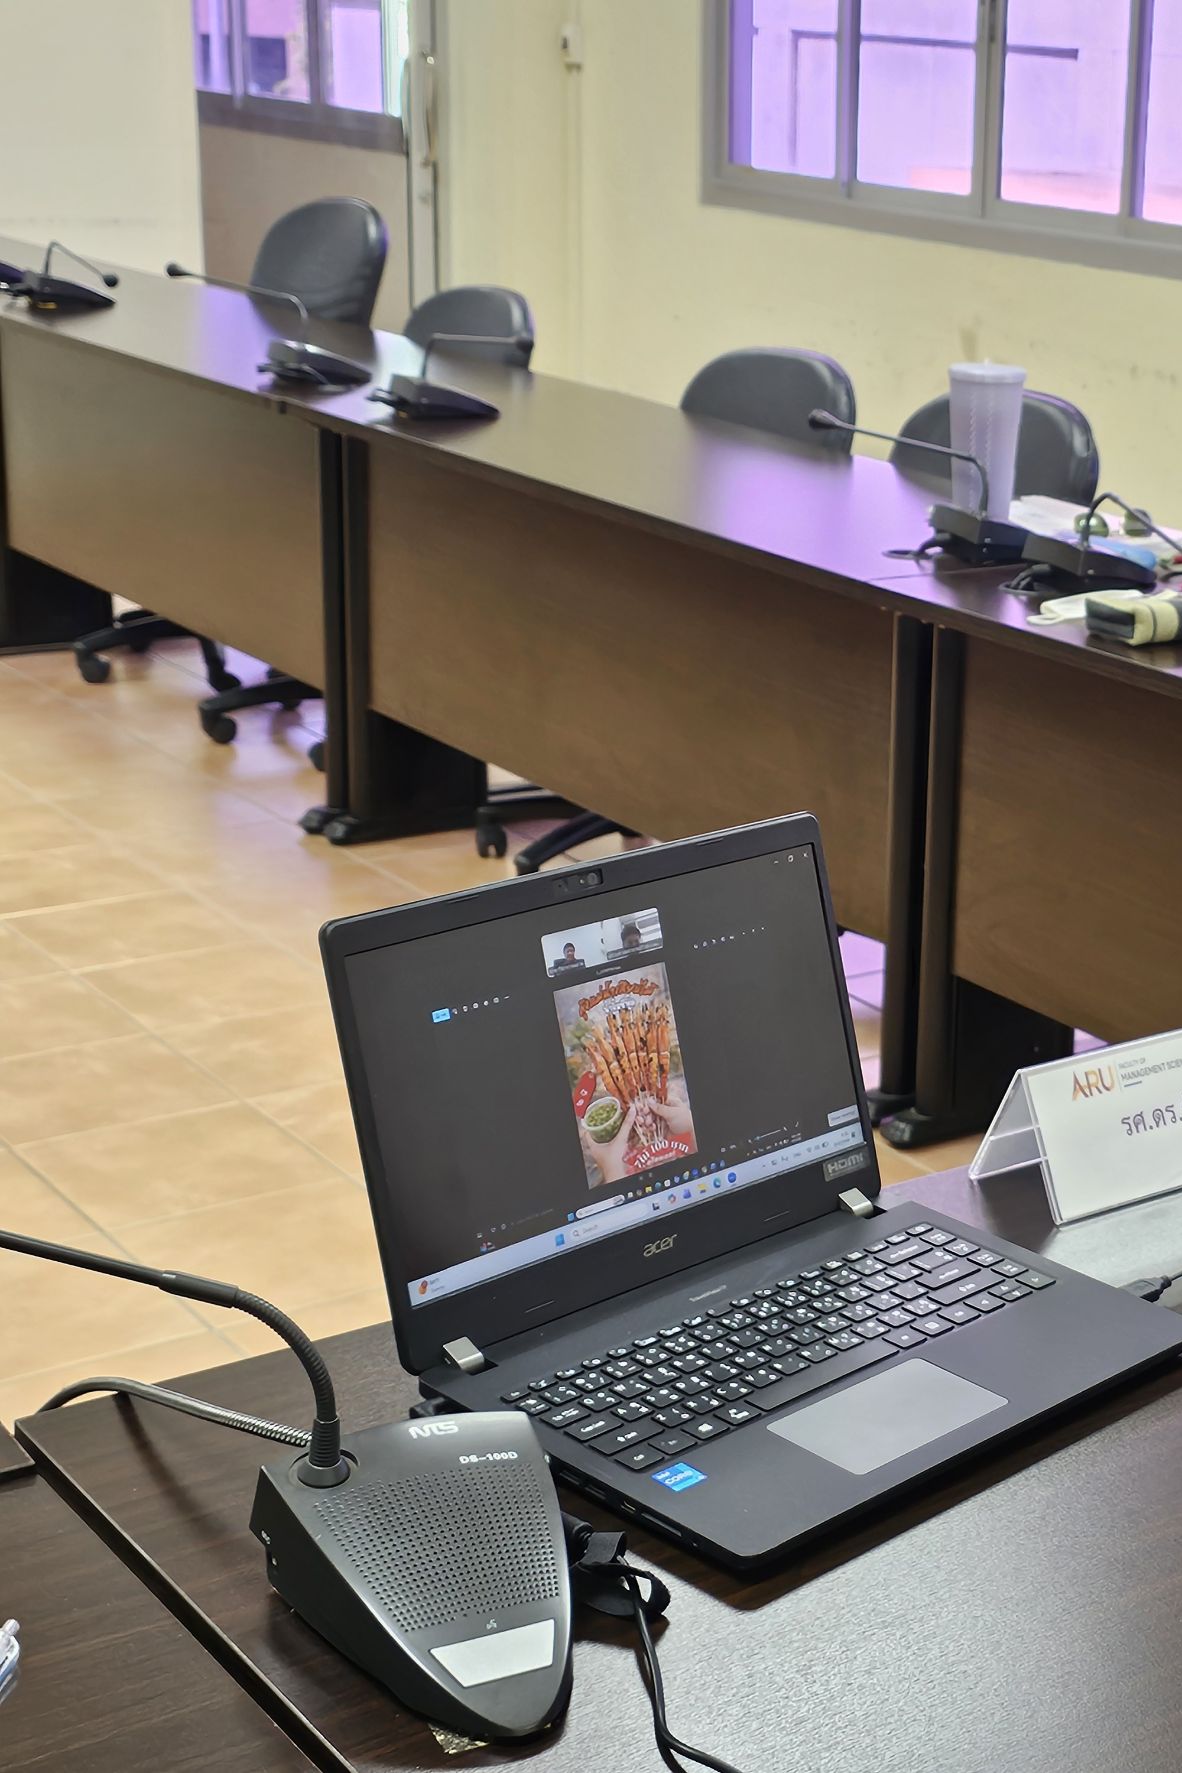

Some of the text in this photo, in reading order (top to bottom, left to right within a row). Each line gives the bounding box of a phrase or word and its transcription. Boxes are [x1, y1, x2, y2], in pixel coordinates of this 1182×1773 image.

[1120, 1063, 1165, 1082] MANAGEMENT
[1072, 1065, 1116, 1101] ARU
[651, 1140, 669, 1153] 100
[827, 1152, 864, 1173] HDMI
[643, 1234, 678, 1257] acer
[458, 1451, 518, 1464] DS-100D
